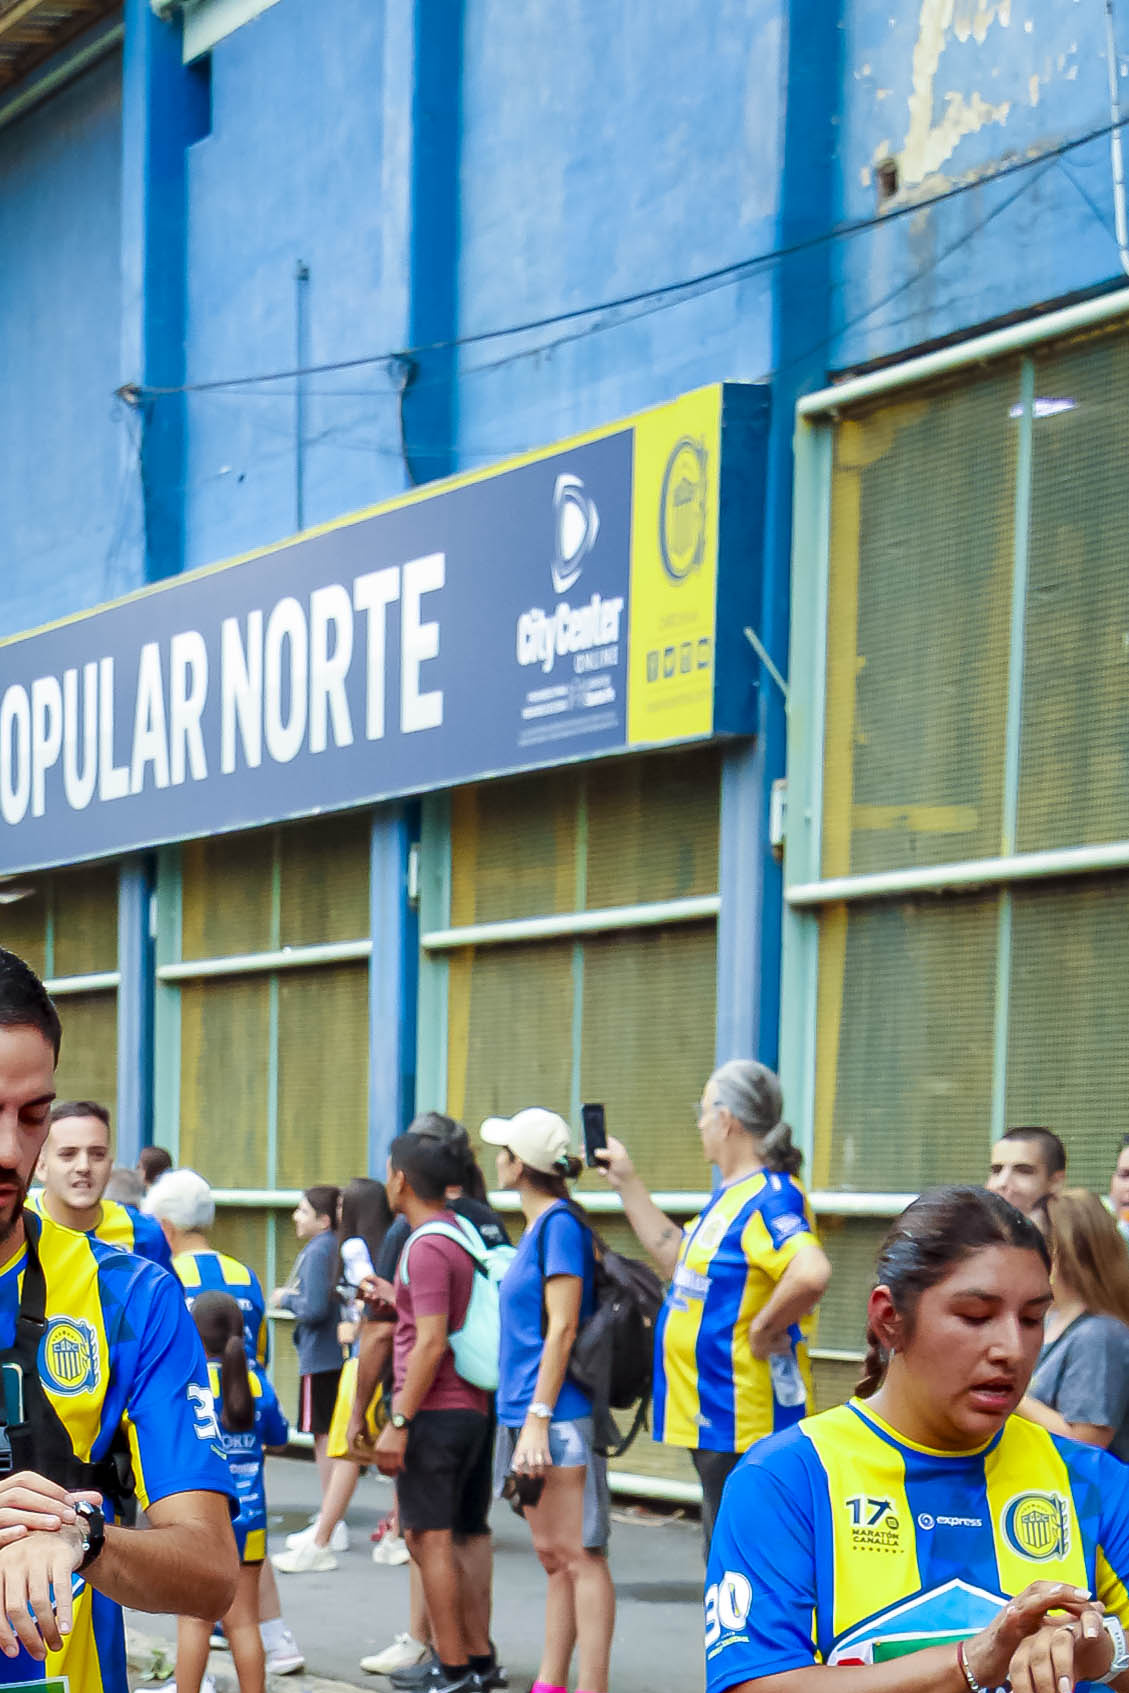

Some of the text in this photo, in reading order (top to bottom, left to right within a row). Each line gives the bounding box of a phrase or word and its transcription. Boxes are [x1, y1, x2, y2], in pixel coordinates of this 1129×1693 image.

[221, 552, 446, 775] NORTE
[845, 1497, 893, 1526] 17
[936, 1515, 983, 1528] express
[852, 1528, 900, 1540] MARATÓN
[853, 1535, 900, 1547] CANALLA
